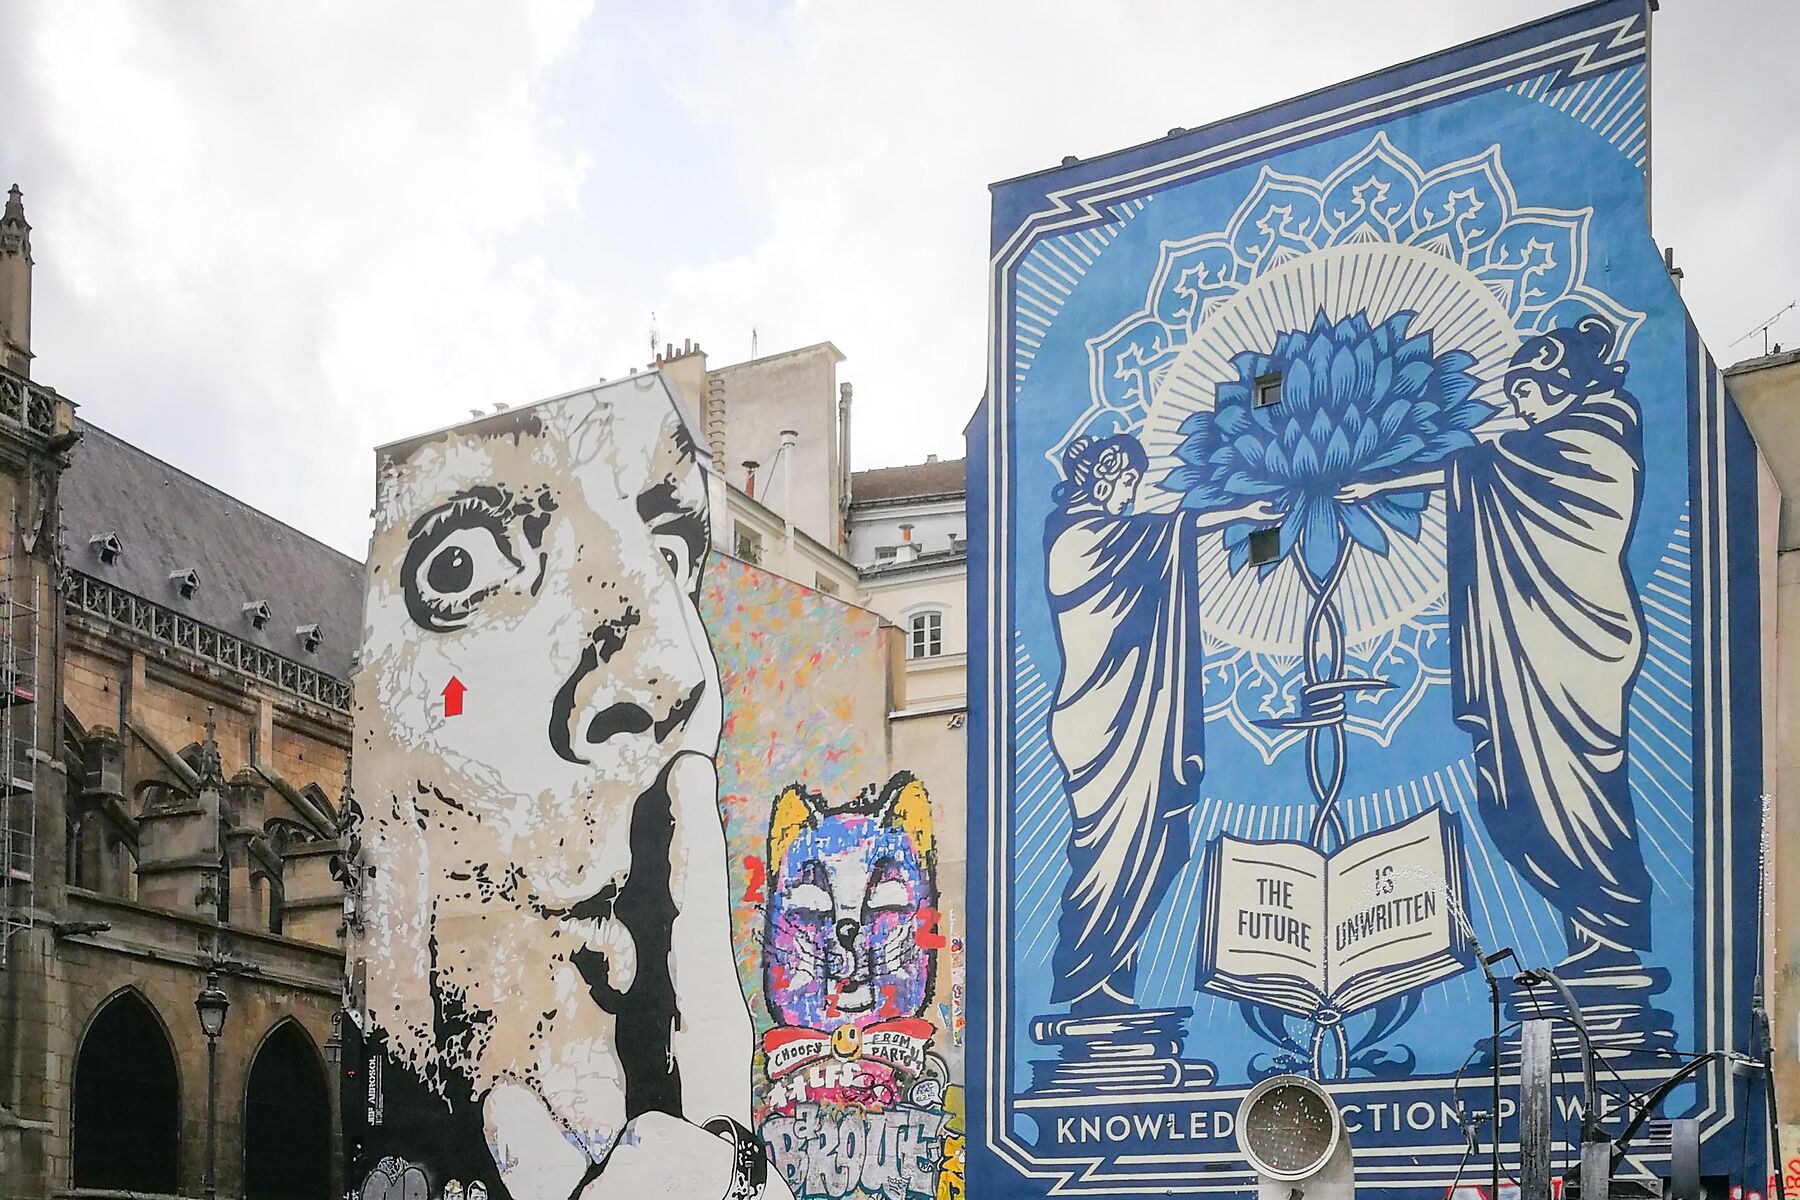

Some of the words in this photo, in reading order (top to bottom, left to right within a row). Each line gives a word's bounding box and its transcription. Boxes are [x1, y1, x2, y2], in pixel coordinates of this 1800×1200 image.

[1256, 878, 1294, 910] THE
[1375, 865, 1395, 897] IS
[1238, 909, 1312, 953] FUTURE
[1335, 890, 1437, 952] UNWRITTEN
[872, 1032, 911, 1048] FROM
[367, 1054, 376, 1105] AEROSOL
[1056, 1110, 1237, 1145] KNOWLED
[1340, 1100, 1465, 1133] CTION
[1497, 1092, 1652, 1128] PWER
